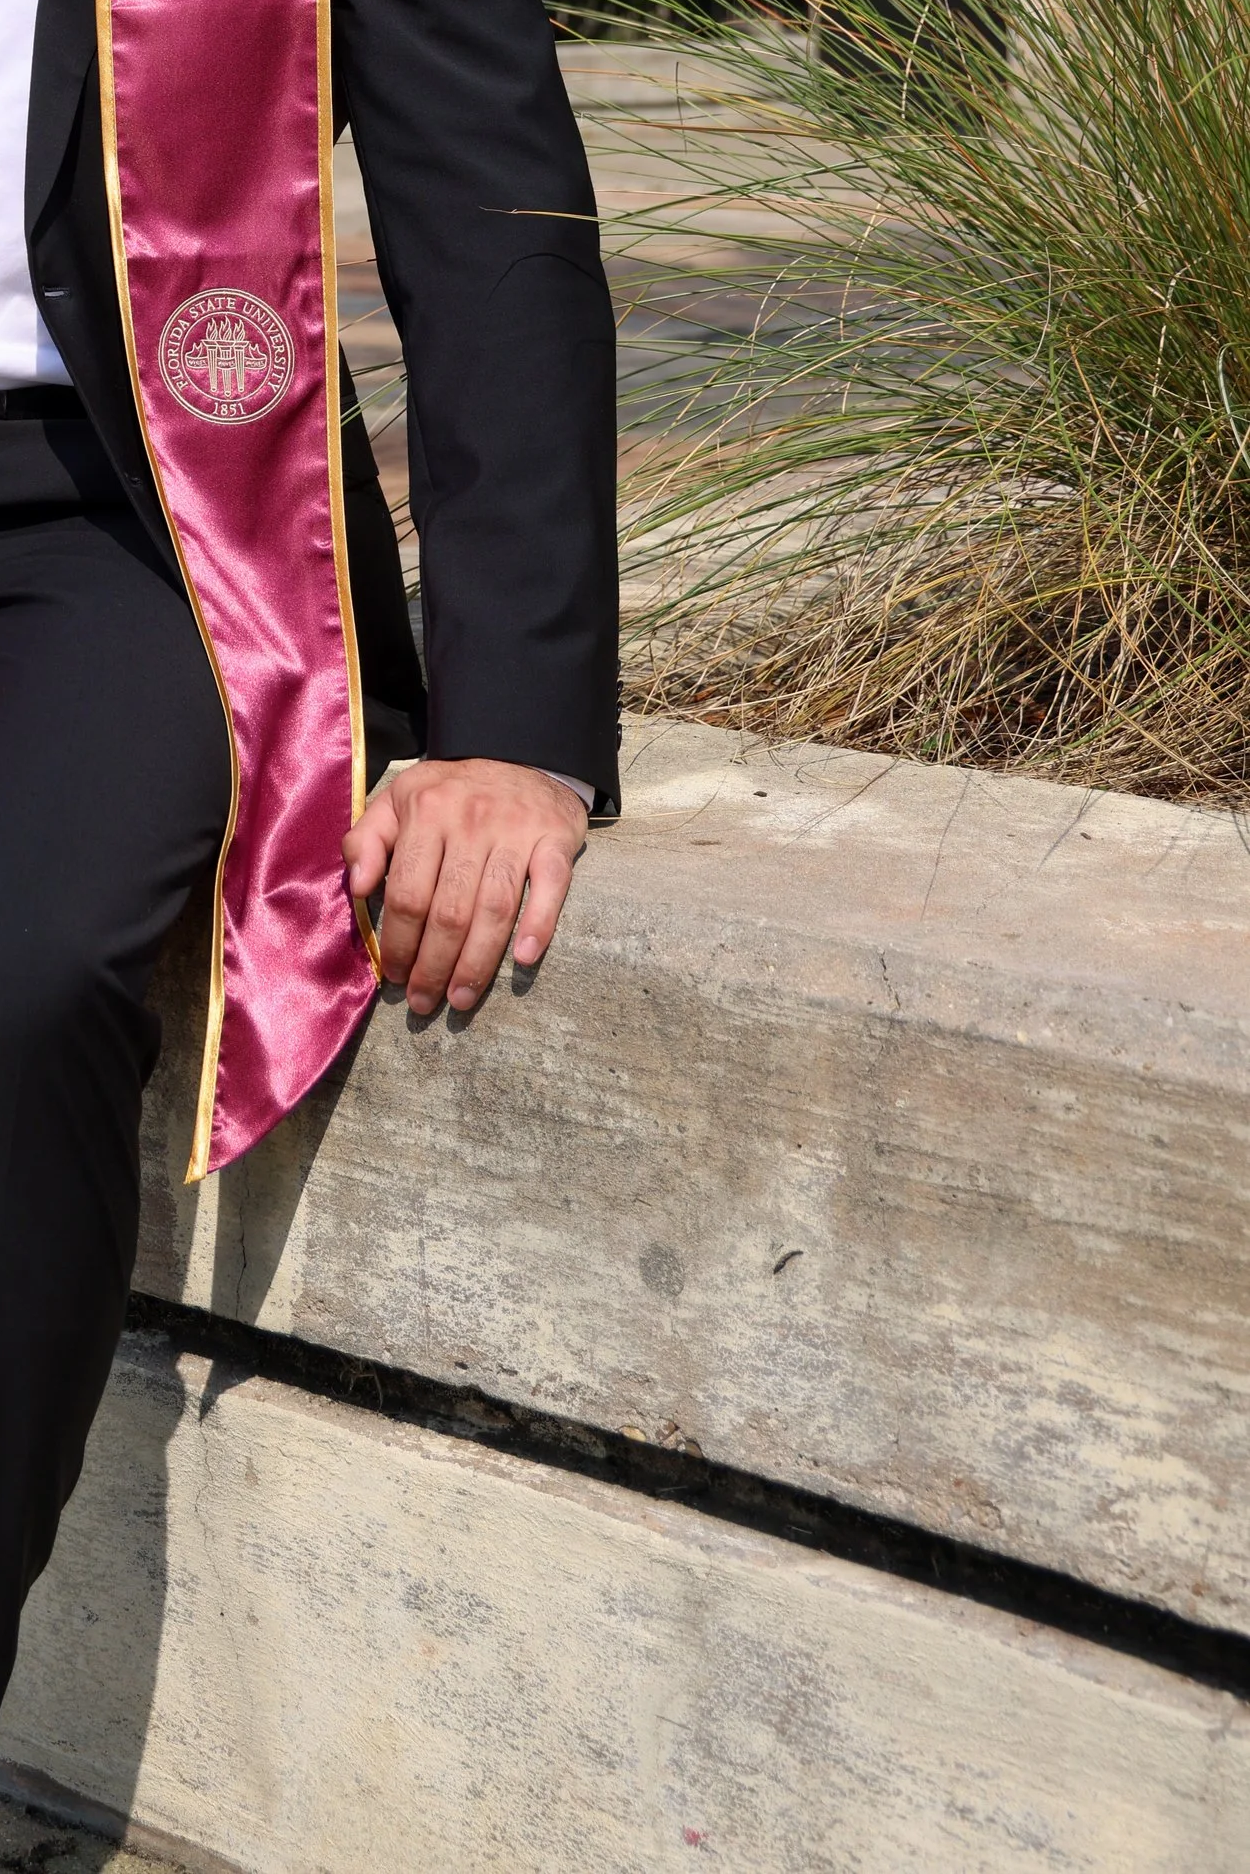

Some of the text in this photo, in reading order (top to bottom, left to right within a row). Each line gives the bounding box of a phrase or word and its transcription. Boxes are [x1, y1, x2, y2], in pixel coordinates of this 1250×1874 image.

[167, 297, 286, 393] FLORIDA STATE UNIVERSITY
[212, 402, 246, 416] 1851
